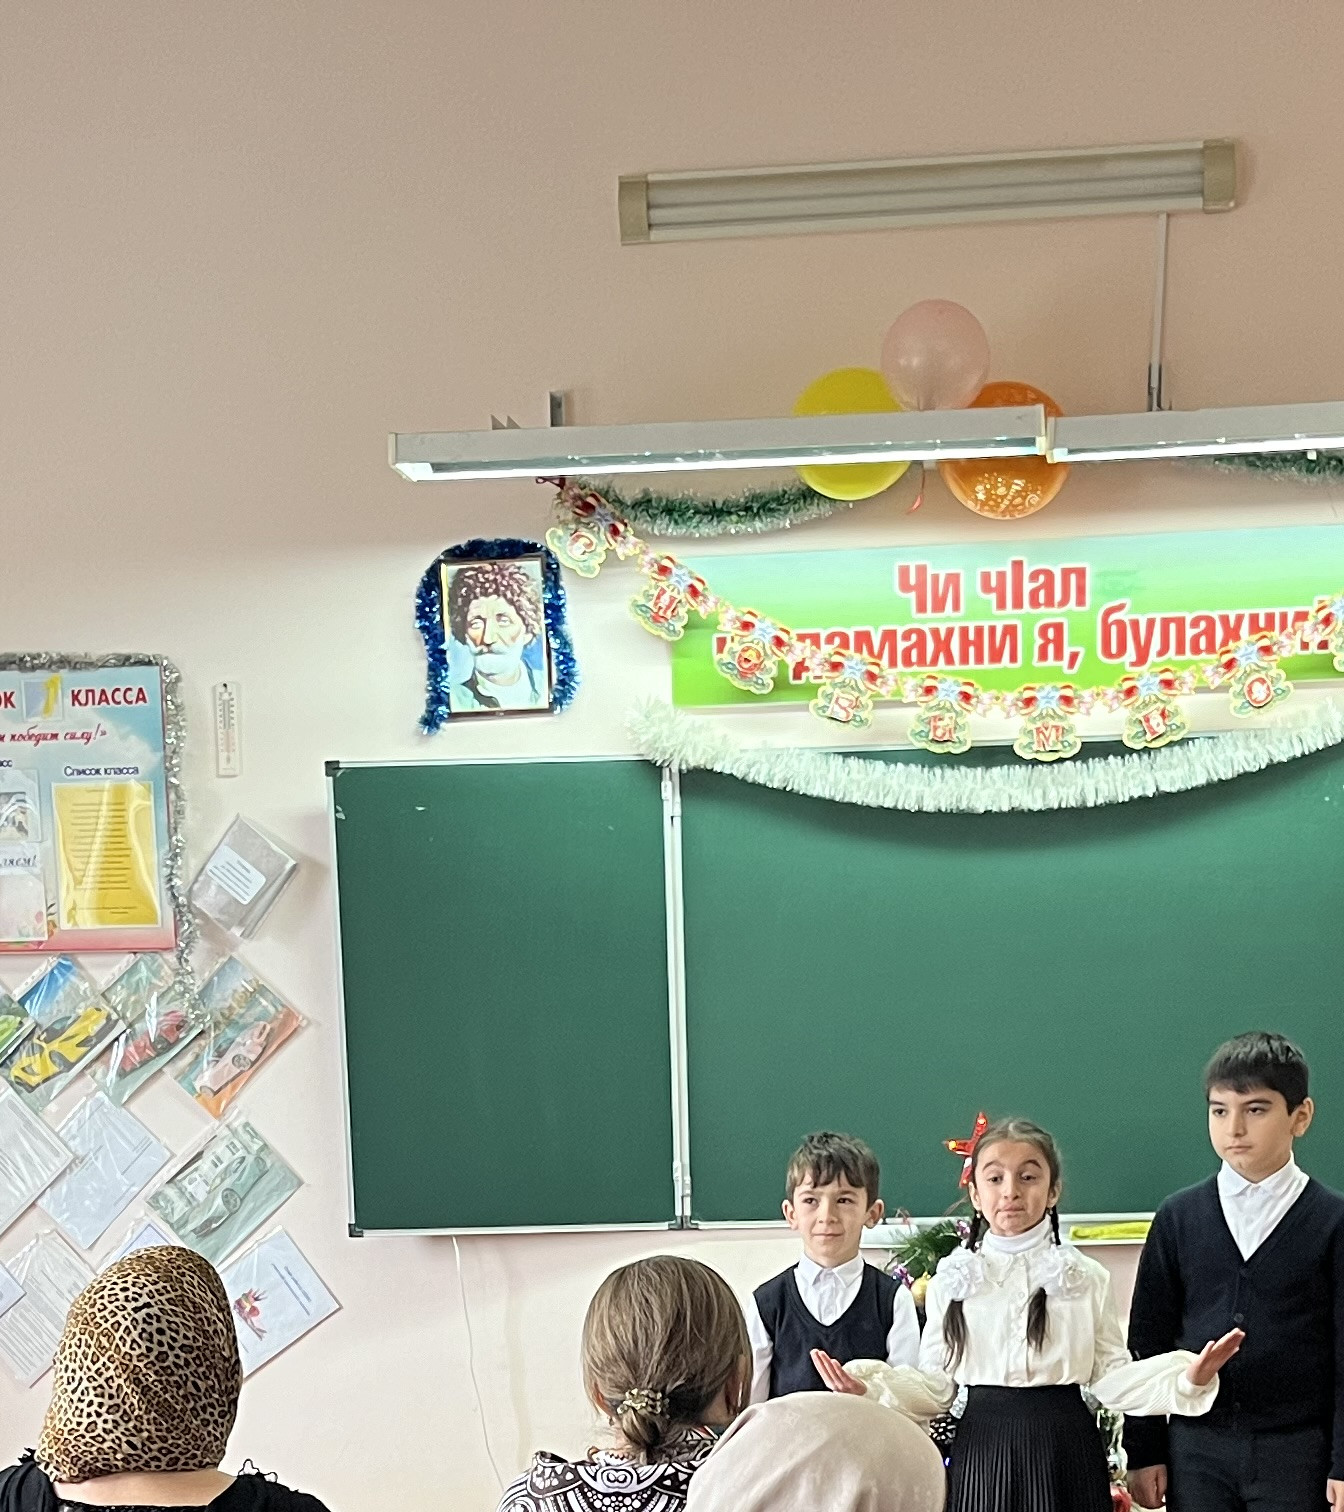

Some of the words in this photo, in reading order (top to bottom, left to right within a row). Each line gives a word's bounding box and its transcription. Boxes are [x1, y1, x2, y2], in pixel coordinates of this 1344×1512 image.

[898, 563, 962, 614] Чи
[1036, 621, 1080, 670] я,
[71, 687, 148, 707] КЛАССА
[10, 725, 60, 745] победит
[64, 766, 102, 778] Список
[103, 765, 140, 776] класса
